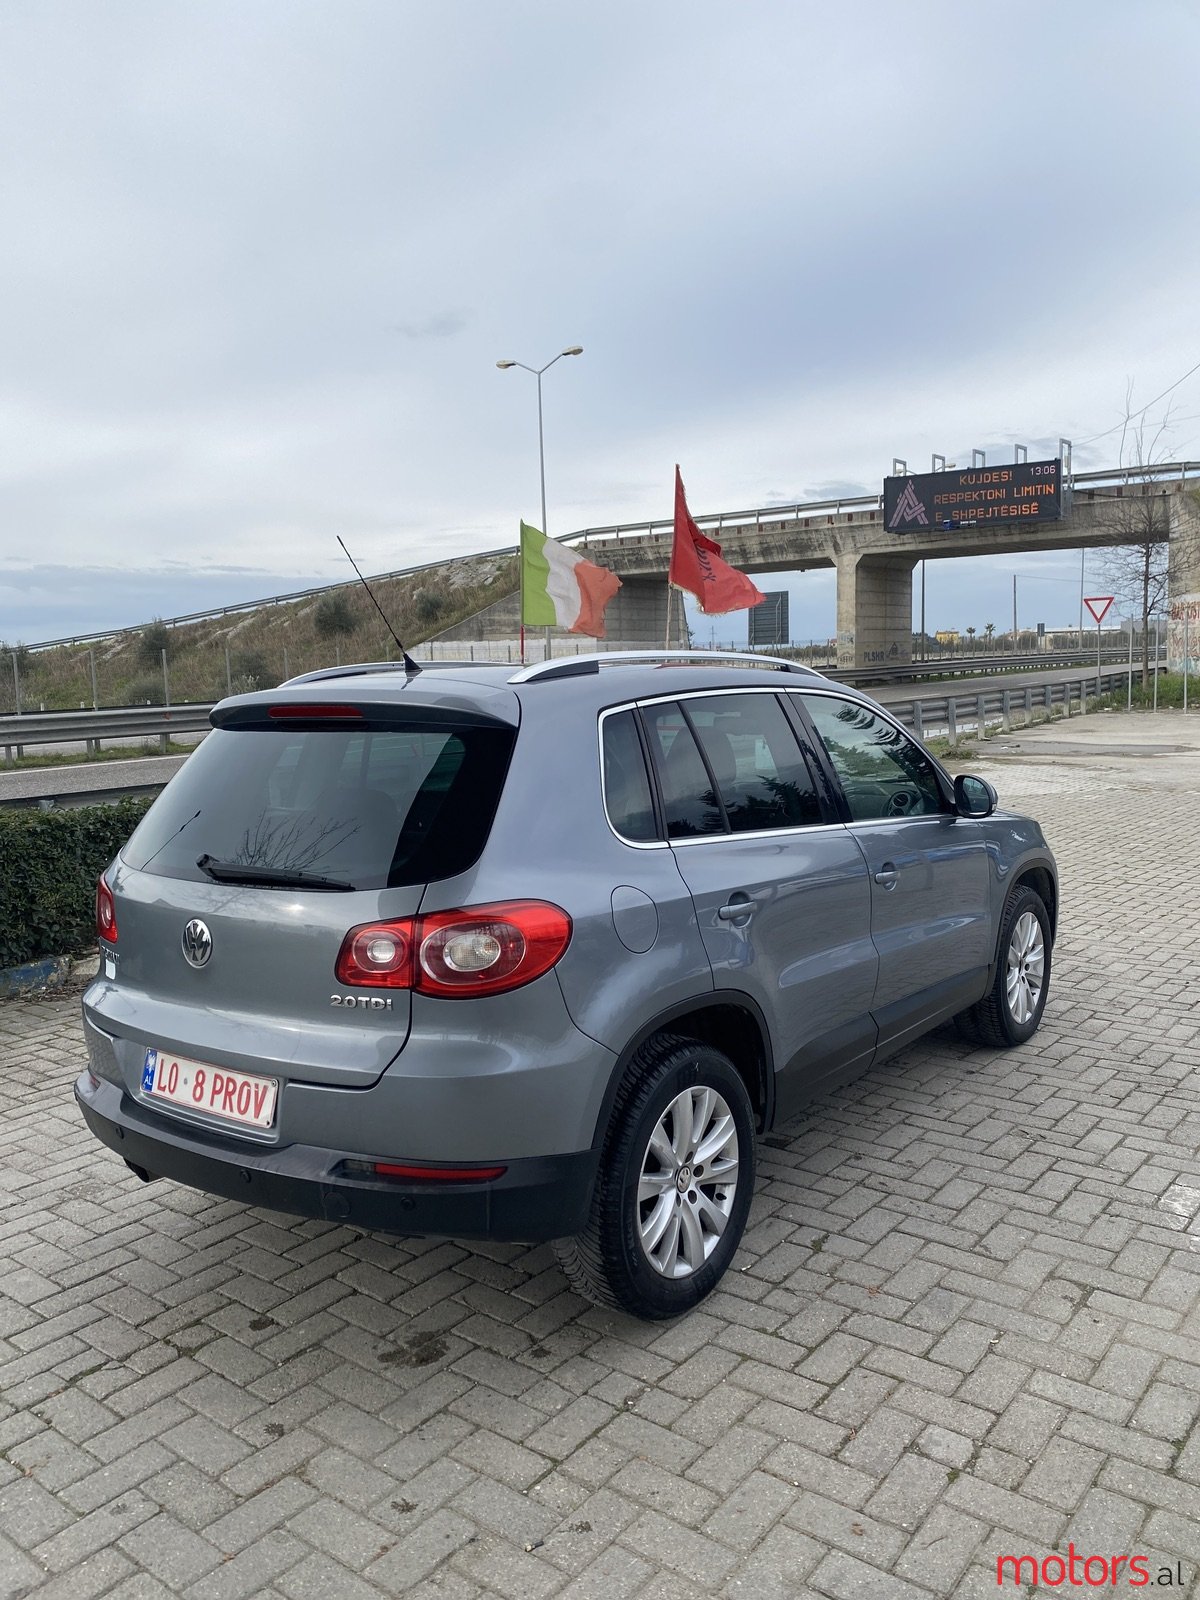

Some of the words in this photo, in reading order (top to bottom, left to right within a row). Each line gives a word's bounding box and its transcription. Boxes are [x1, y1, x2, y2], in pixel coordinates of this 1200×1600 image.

[960, 471, 1012, 485] KUJDES!
[1030, 466, 1055, 476] 13:06
[934, 489, 1005, 504] RESPEKTONI
[1014, 484, 1054, 497] LIMITIN
[935, 512, 943, 522] E
[952, 502, 1039, 521] SHPEJTËSISË
[192, 1069, 206, 1103] 8
[210, 1074, 269, 1118] PROV
